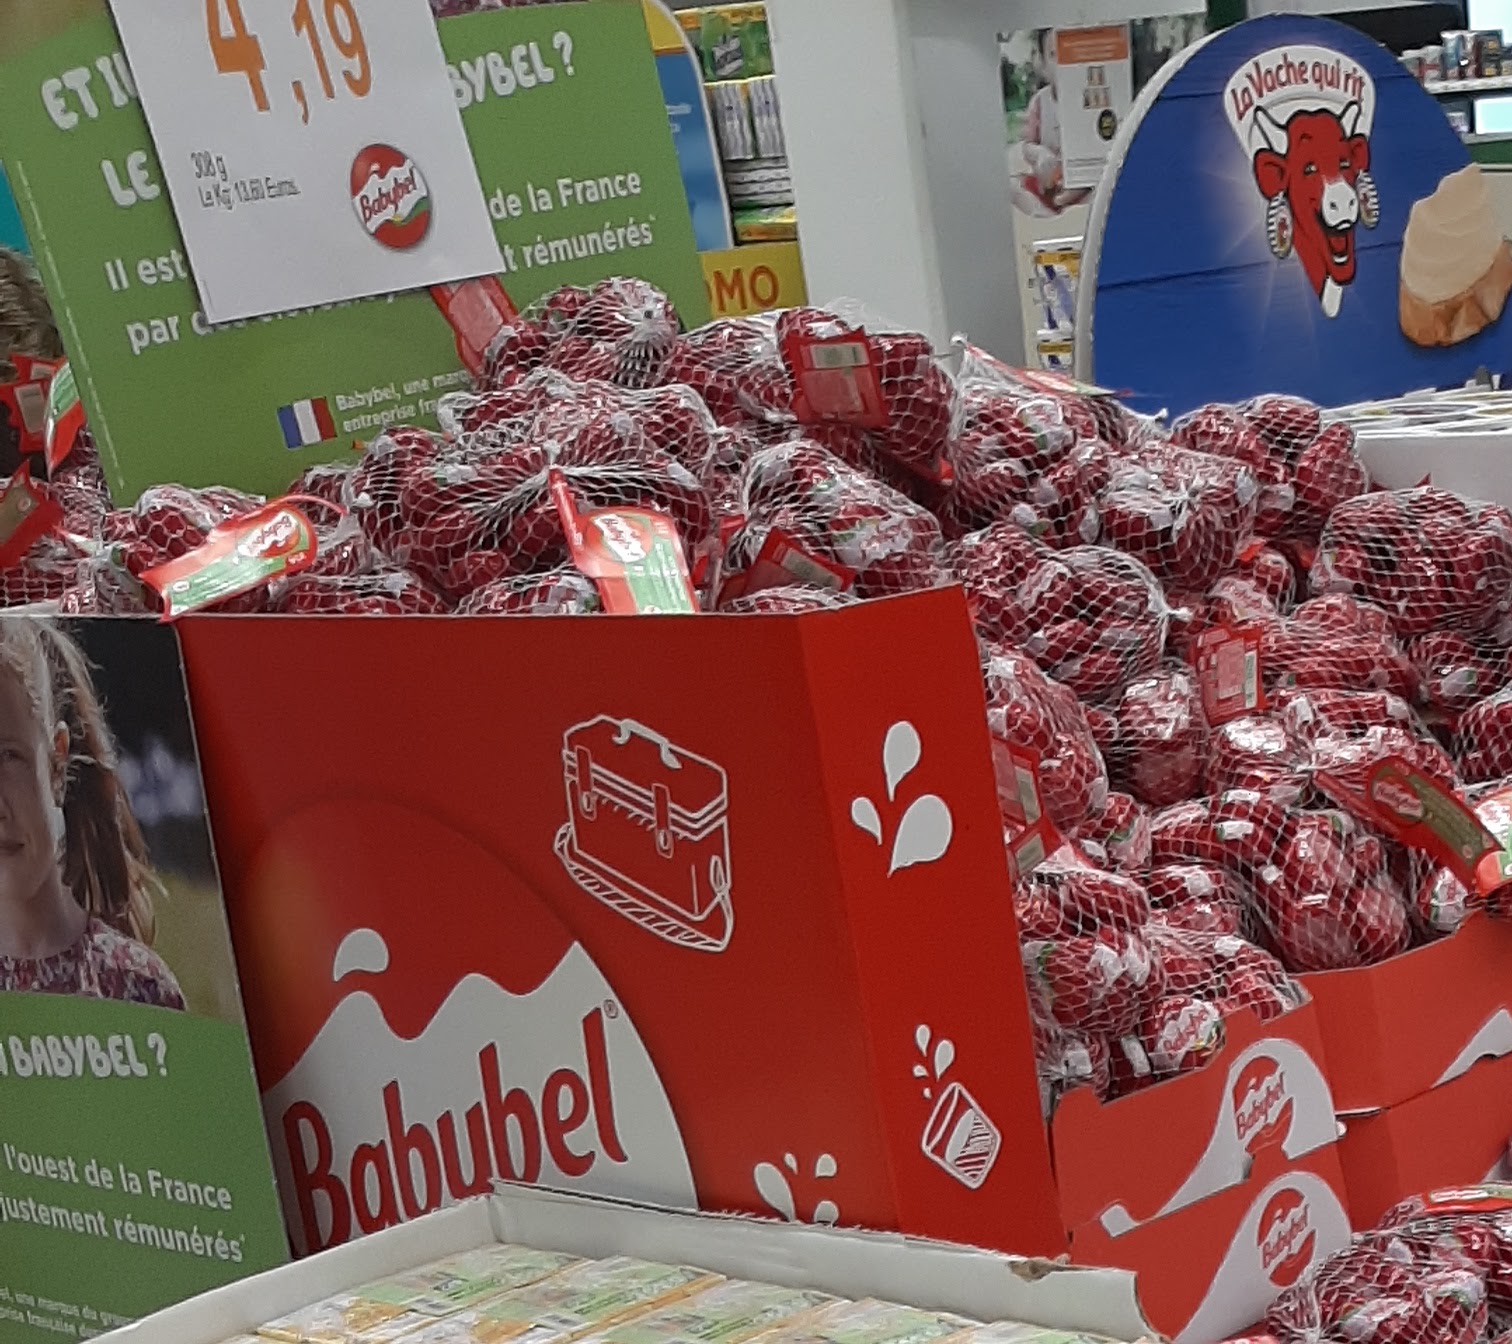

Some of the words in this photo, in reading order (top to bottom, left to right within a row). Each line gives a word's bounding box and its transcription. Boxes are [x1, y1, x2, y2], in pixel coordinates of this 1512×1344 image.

[42, 67, 98, 130] ET
[447, 42, 555, 108] BYBEL
[1230, 87, 1254, 121] La
[1245, 52, 1308, 98] Vache
[1312, 58, 1341, 91] qui
[102, 151, 160, 207] LE
[360, 167, 418, 224] Babybel
[488, 188, 522, 219] de
[527, 181, 552, 213] la
[557, 172, 642, 207] France
[137, 250, 188, 285] est
[523, 217, 653, 268] rémunérés
[704, 265, 779, 312] MO
[126, 315, 180, 355] par
[8, 1034, 148, 1078] BABYBEL
[147, 1032, 168, 1077] ?
[1237, 1070, 1286, 1141] Babybel
[3, 1143, 79, 1184] l'ouest
[85, 1159, 114, 1190] de
[119, 1163, 142, 1195] la
[147, 1169, 232, 1211] France
[113, 1213, 243, 1263] rémunérés
[1262, 1203, 1310, 1270] Babybel
